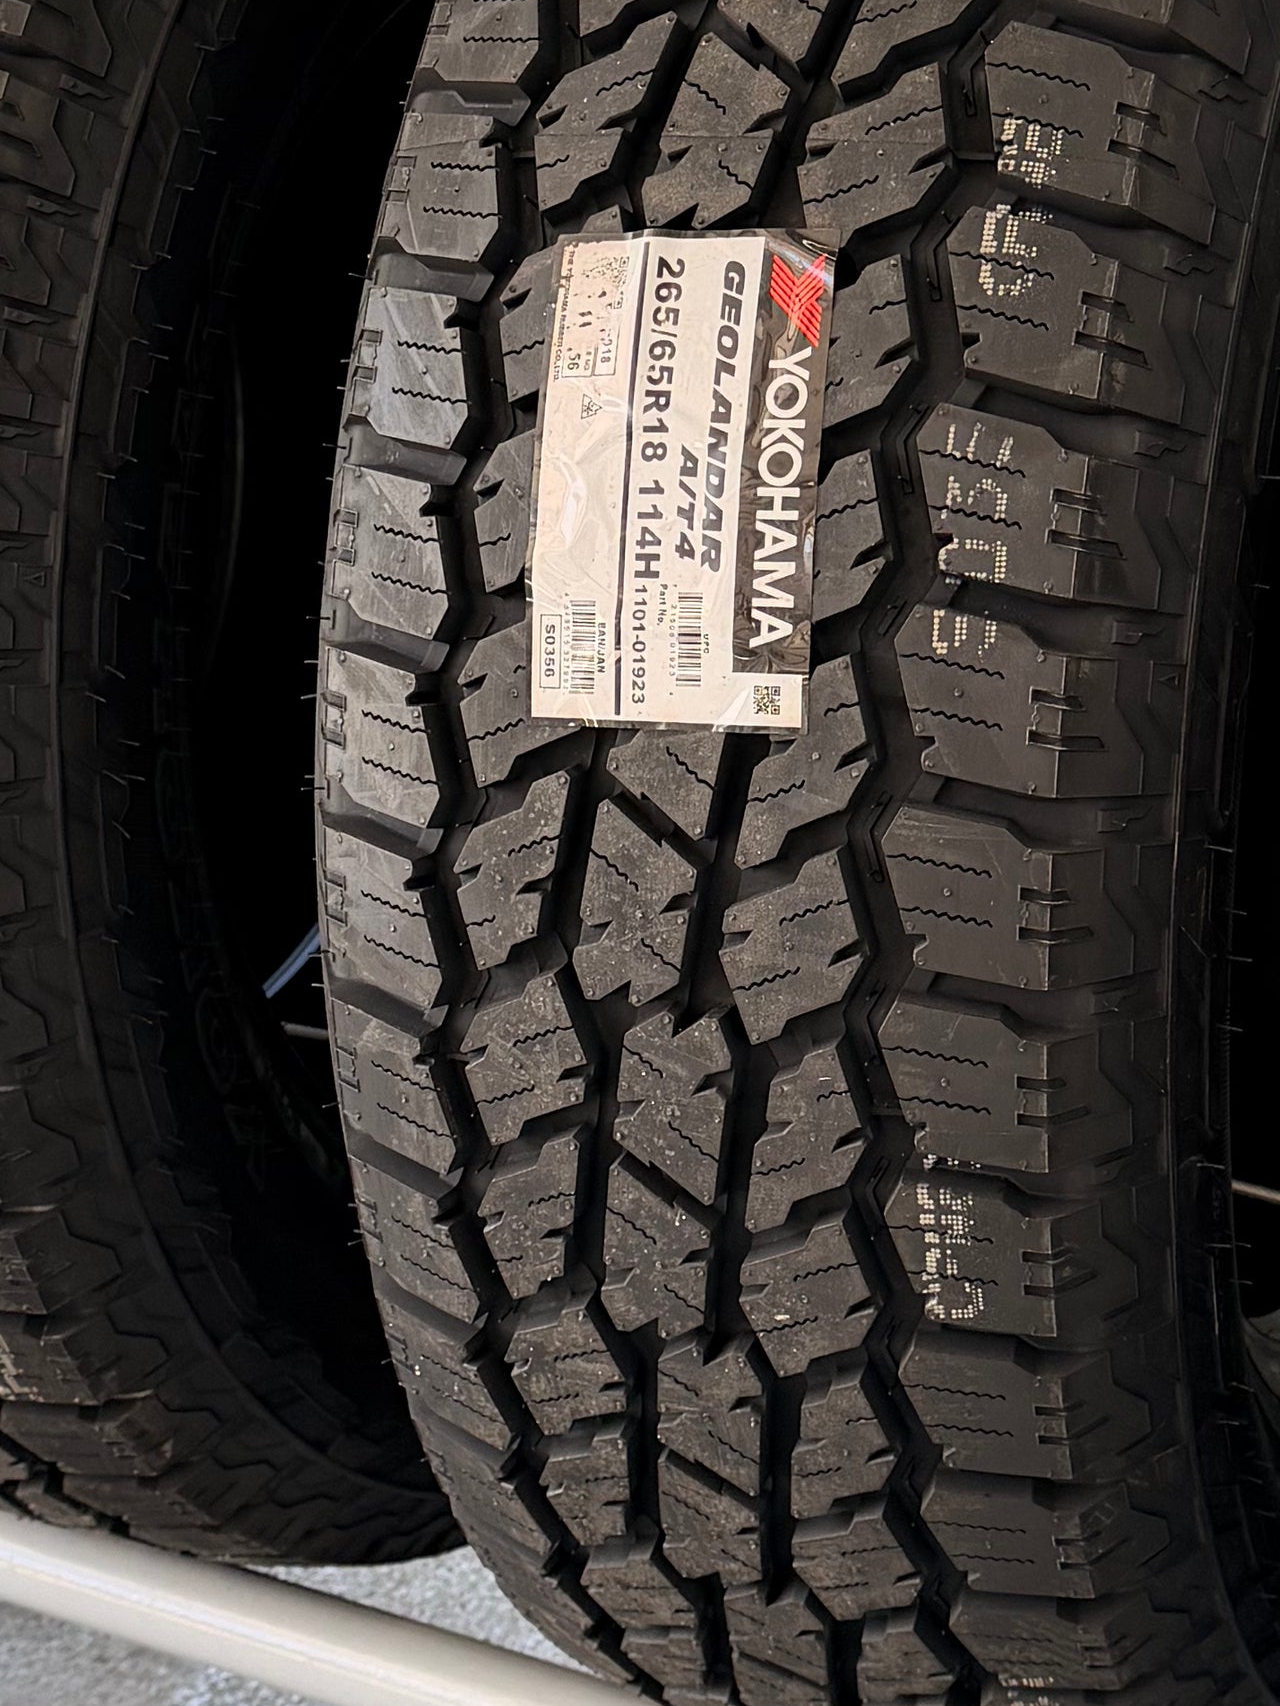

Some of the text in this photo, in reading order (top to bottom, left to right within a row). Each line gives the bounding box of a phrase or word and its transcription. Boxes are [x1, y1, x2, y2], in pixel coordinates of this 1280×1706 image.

[634, 255, 685, 580] 265/65R18 114H
[675, 444, 700, 561] A/T4
[700, 260, 746, 573] GEOLANDAR
[749, 347, 812, 648] YOKOHAMA
[631, 584, 648, 704] 1101-01923
[656, 583, 668, 626] Part No.
